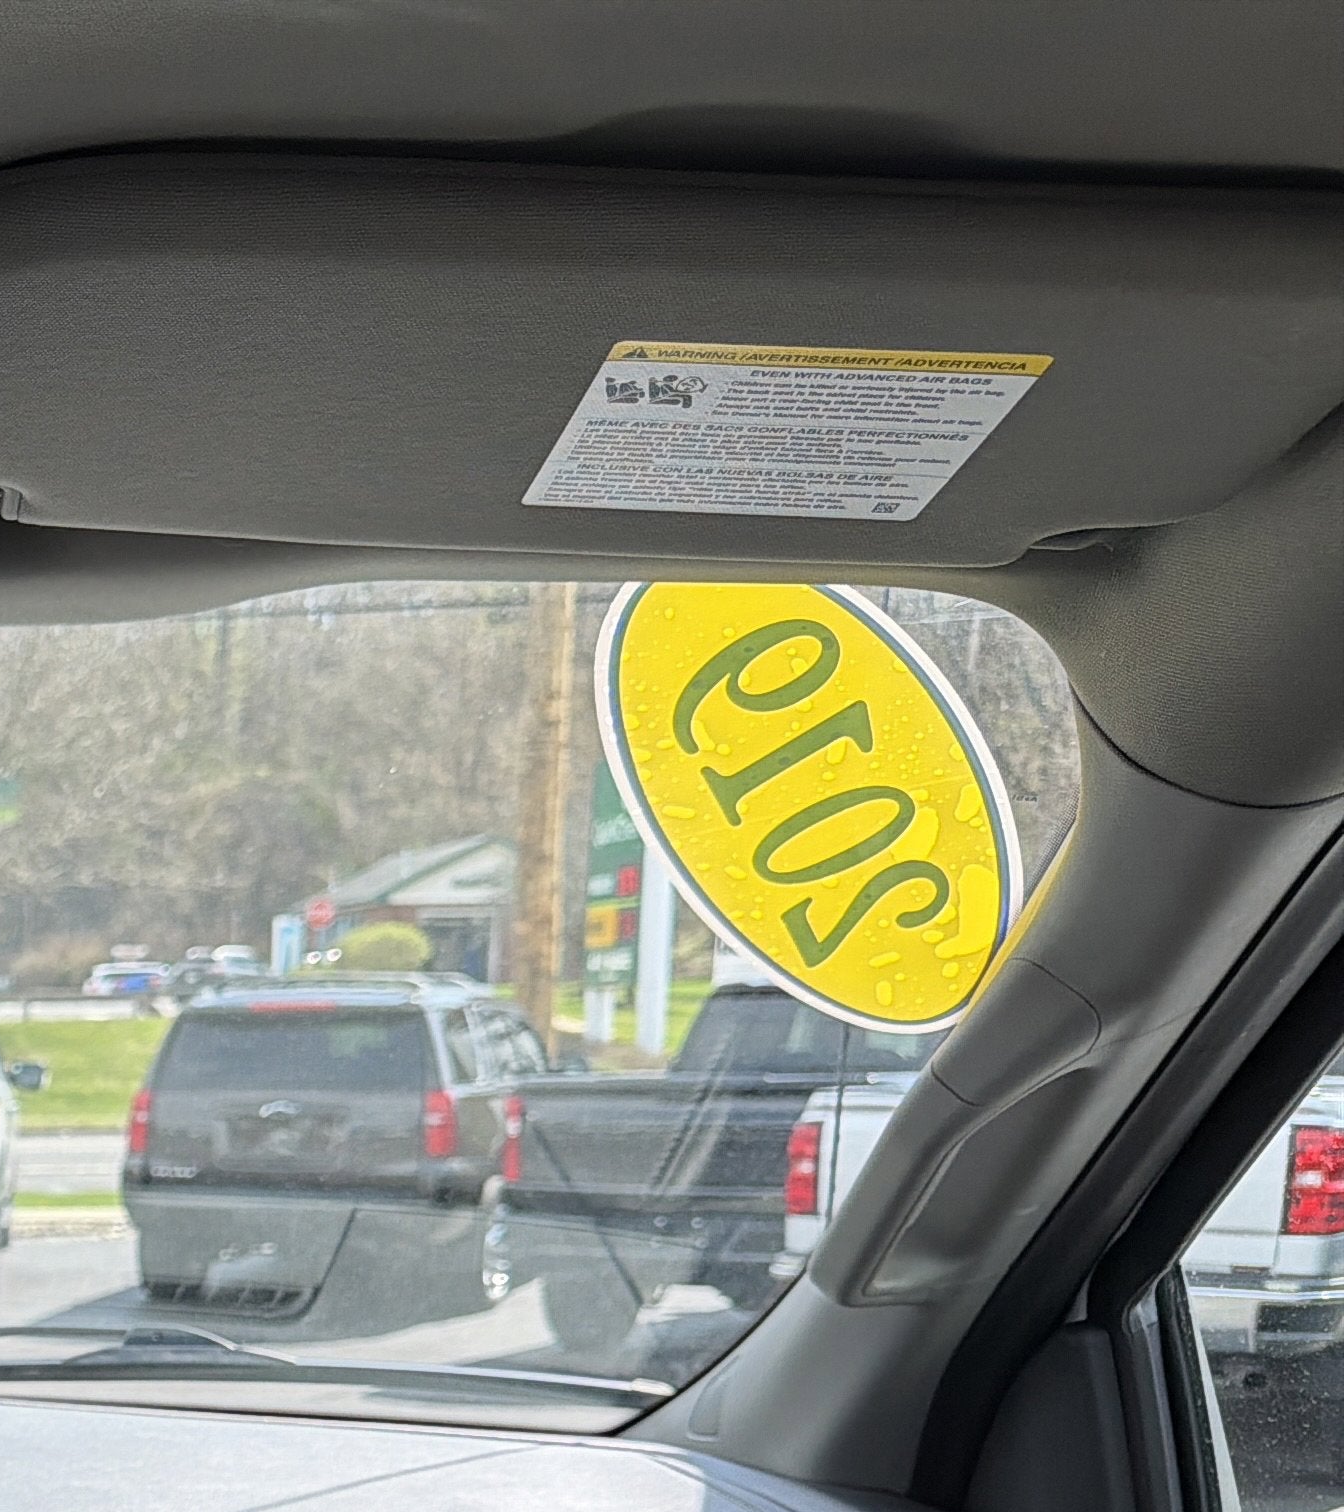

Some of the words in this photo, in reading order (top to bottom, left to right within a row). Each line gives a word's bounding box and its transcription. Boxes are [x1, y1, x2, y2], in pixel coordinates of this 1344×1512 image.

[657, 349, 737, 361] WARNING
[750, 369, 791, 378] EVEN
[794, 371, 832, 380] WITH
[834, 372, 917, 383] ADVANCED
[917, 376, 947, 384] AIR
[948, 377, 993, 386] BAGS
[630, 421, 668, 430] AVEC
[671, 423, 701, 431] DES
[703, 424, 744, 433] SACS
[746, 426, 844, 437] GONFLABLES
[577, 463, 650, 472] INCLUSIVE
[652, 466, 683, 474] CON
[686, 467, 714, 475] LAS
[717, 468, 773, 477] NUEVAS
[775, 471, 835, 480] BOLSAS
